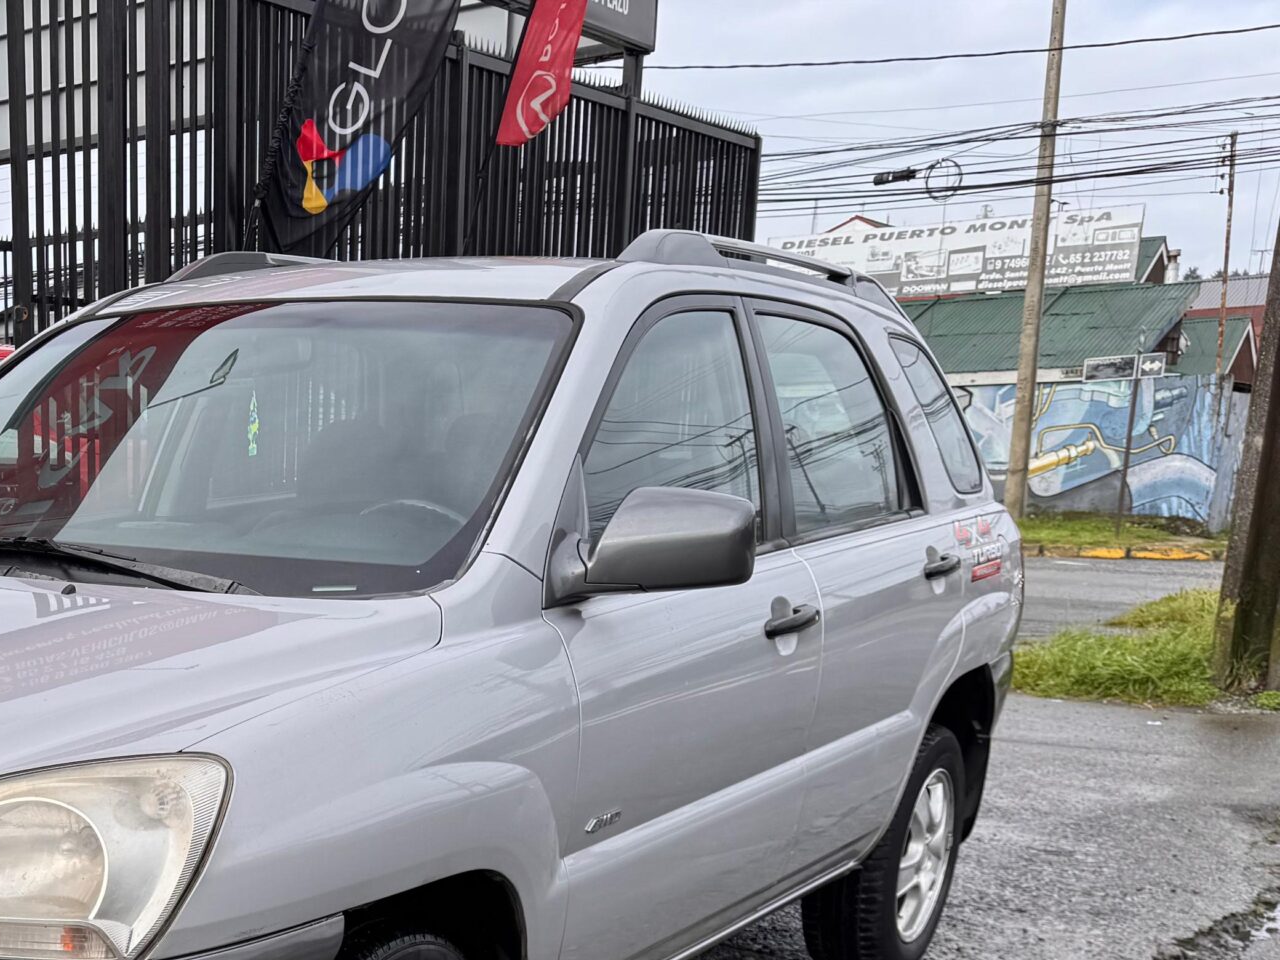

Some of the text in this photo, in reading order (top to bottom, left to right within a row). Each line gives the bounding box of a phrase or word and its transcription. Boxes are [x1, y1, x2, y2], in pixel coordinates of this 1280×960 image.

[781, 236, 854, 250] DIESEL
[862, 226, 957, 243] PUERTO
[1064, 211, 1112, 226] SpA
[1083, 252, 1091, 262] 2
[1092, 249, 1130, 262] 237782
[1074, 264, 1102, 273] Puerto
[973, 542, 1002, 564] TURBO
